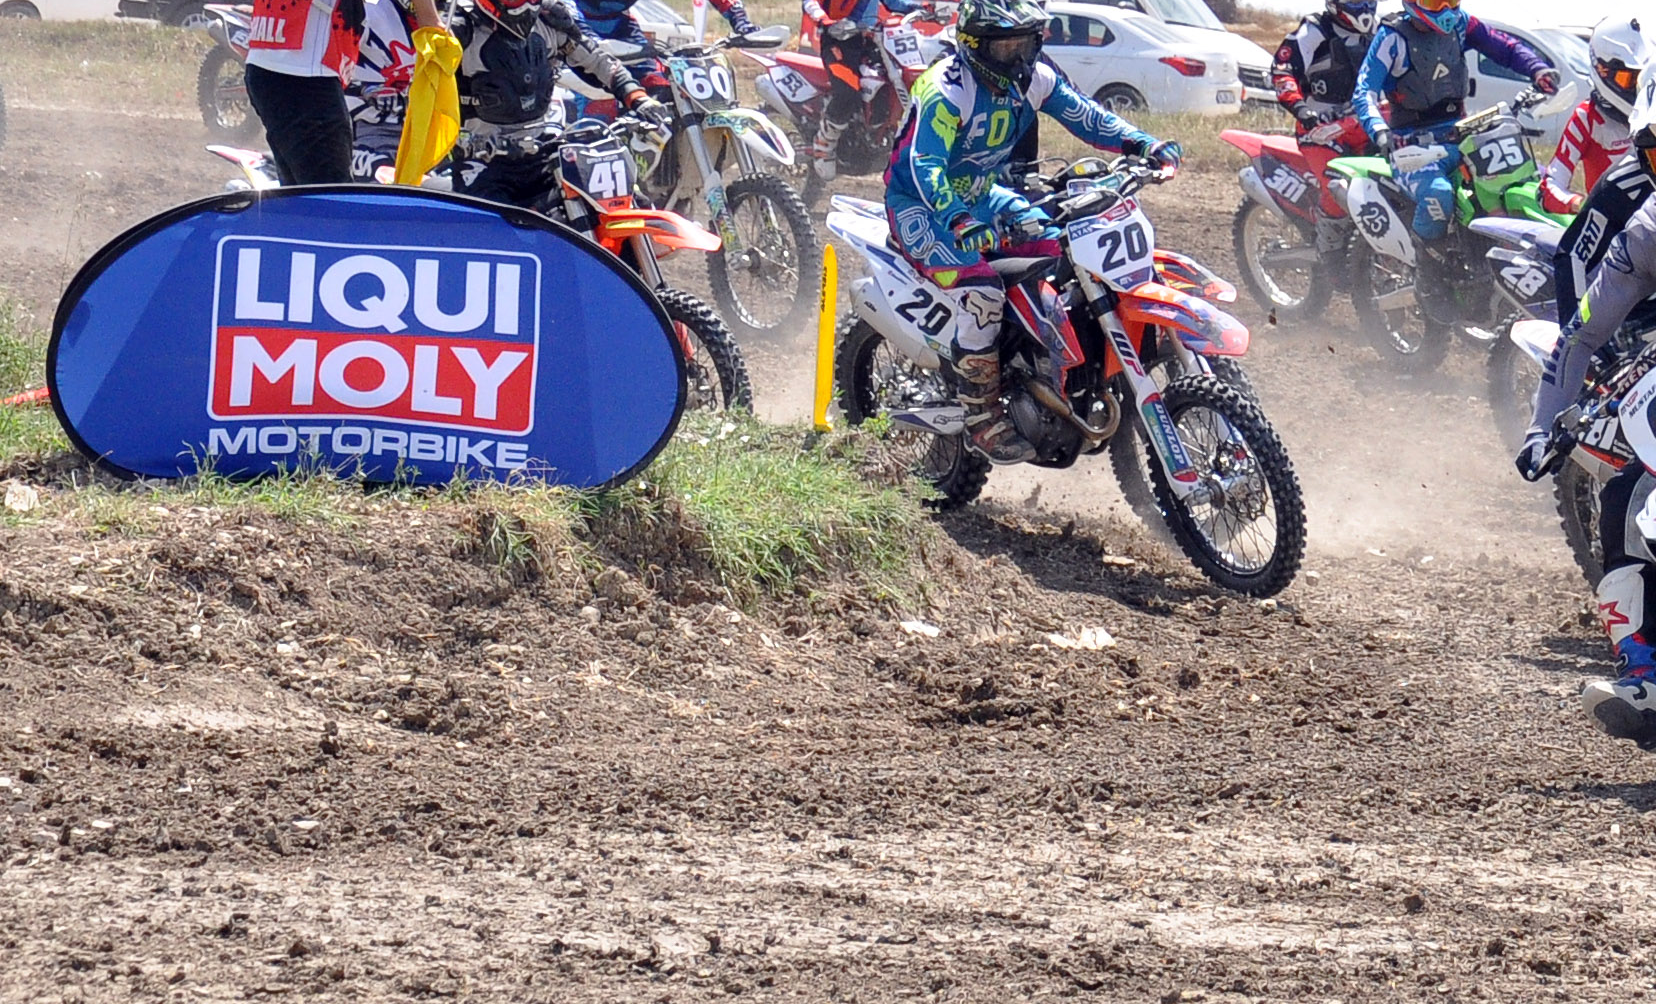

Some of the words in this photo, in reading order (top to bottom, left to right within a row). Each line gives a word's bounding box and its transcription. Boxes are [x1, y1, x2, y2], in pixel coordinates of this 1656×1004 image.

[893, 35, 918, 55] 53
[684, 65, 731, 100] 60
[1479, 137, 1524, 174] 25
[588, 159, 628, 198] 41
[1362, 207, 1388, 233] 25
[1424, 197, 1446, 222] FOX
[1097, 221, 1148, 273] 20
[235, 248, 520, 334] LIQUI
[1500, 263, 1547, 296] 28
[894, 287, 952, 337] 20
[229, 335, 528, 421] MOLY
[208, 426, 530, 470] MOTORBIKE
[1154, 402, 1186, 466] DUNLOP
